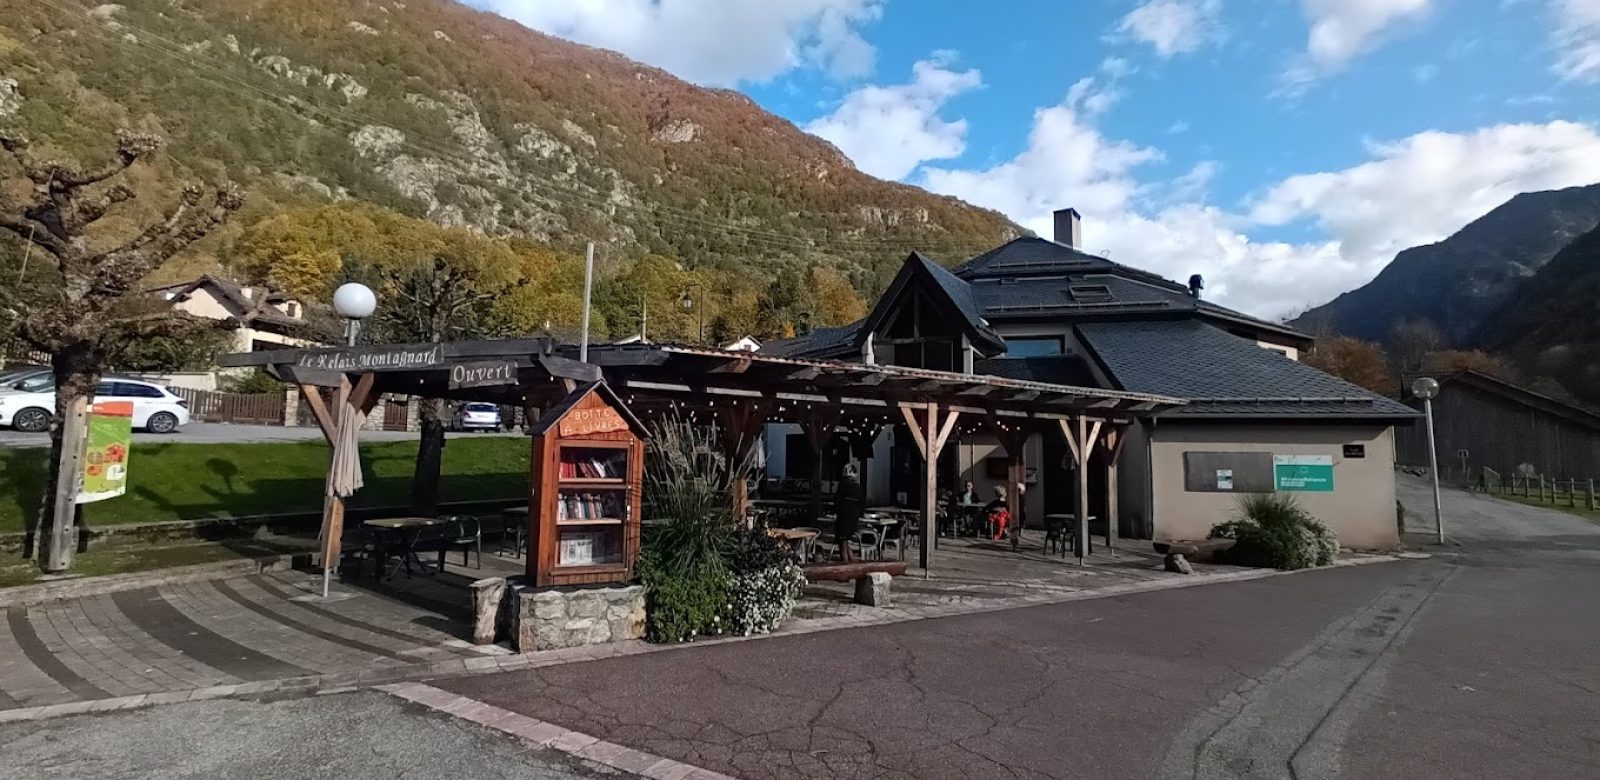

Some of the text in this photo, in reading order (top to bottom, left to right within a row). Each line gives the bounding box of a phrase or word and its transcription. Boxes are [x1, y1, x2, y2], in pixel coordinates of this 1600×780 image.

[299, 346, 438, 369] Le Relais Montagnard
[453, 364, 511, 382] Ouvert
[583, 420, 620, 432] LIVRES
